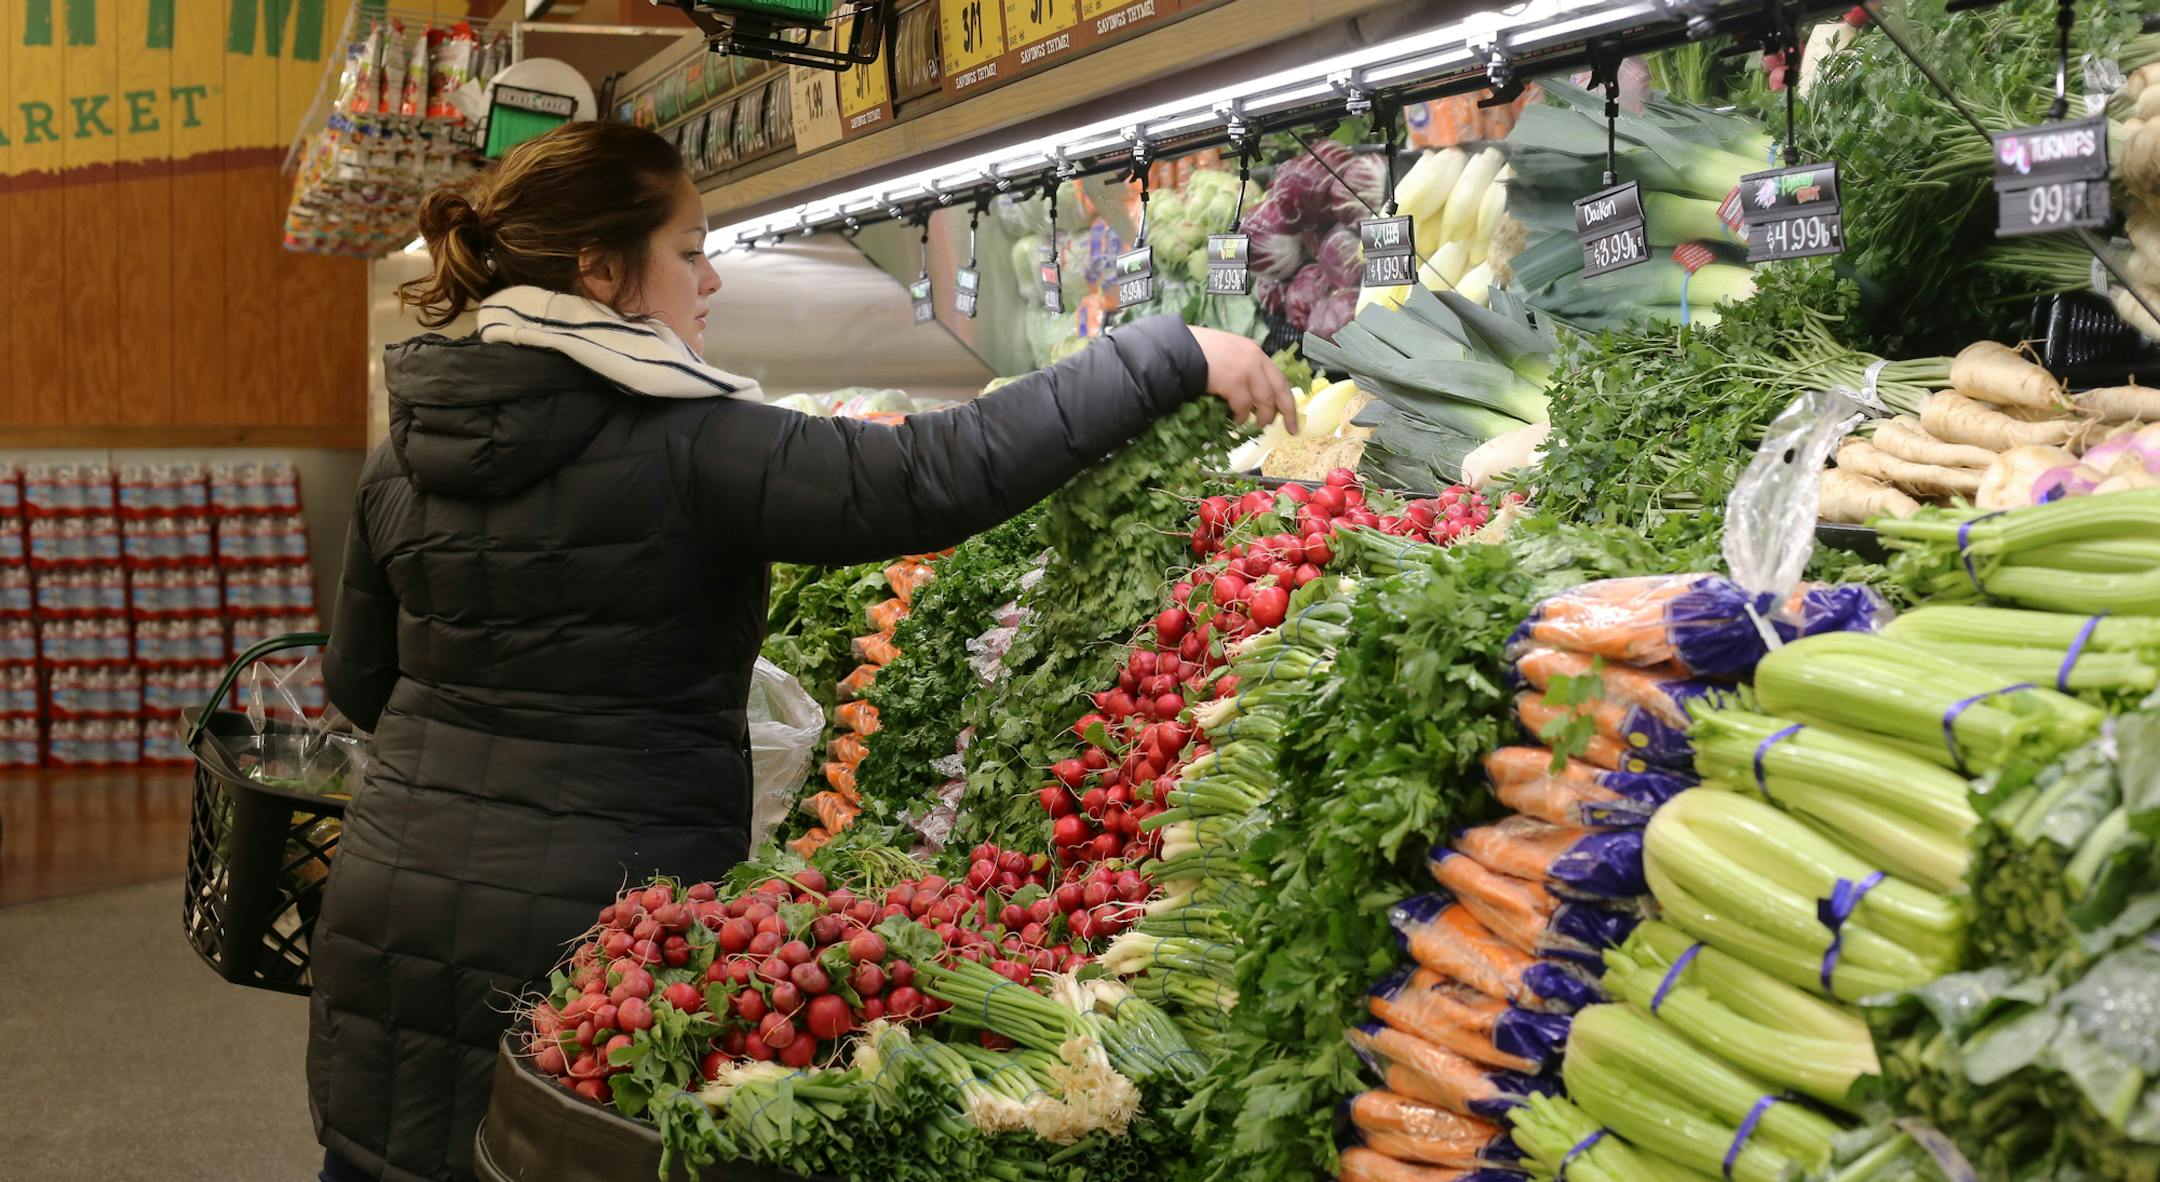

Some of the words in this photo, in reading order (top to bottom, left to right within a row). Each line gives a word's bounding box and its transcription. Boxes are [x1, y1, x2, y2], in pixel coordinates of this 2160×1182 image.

[1096, 11, 1127, 34] SAVINGS
[1126, 0, 1155, 23] THYME!
[1020, 44, 1046, 64] SAVINGS
[1046, 33, 1070, 54] THYME!
[956, 70, 976, 89] SAVINGS
[977, 62, 997, 82] THYME!
[0, 86, 207, 146] RKET
[2030, 130, 2095, 163] TURNIPS
[1584, 200, 1616, 226] Daikon
